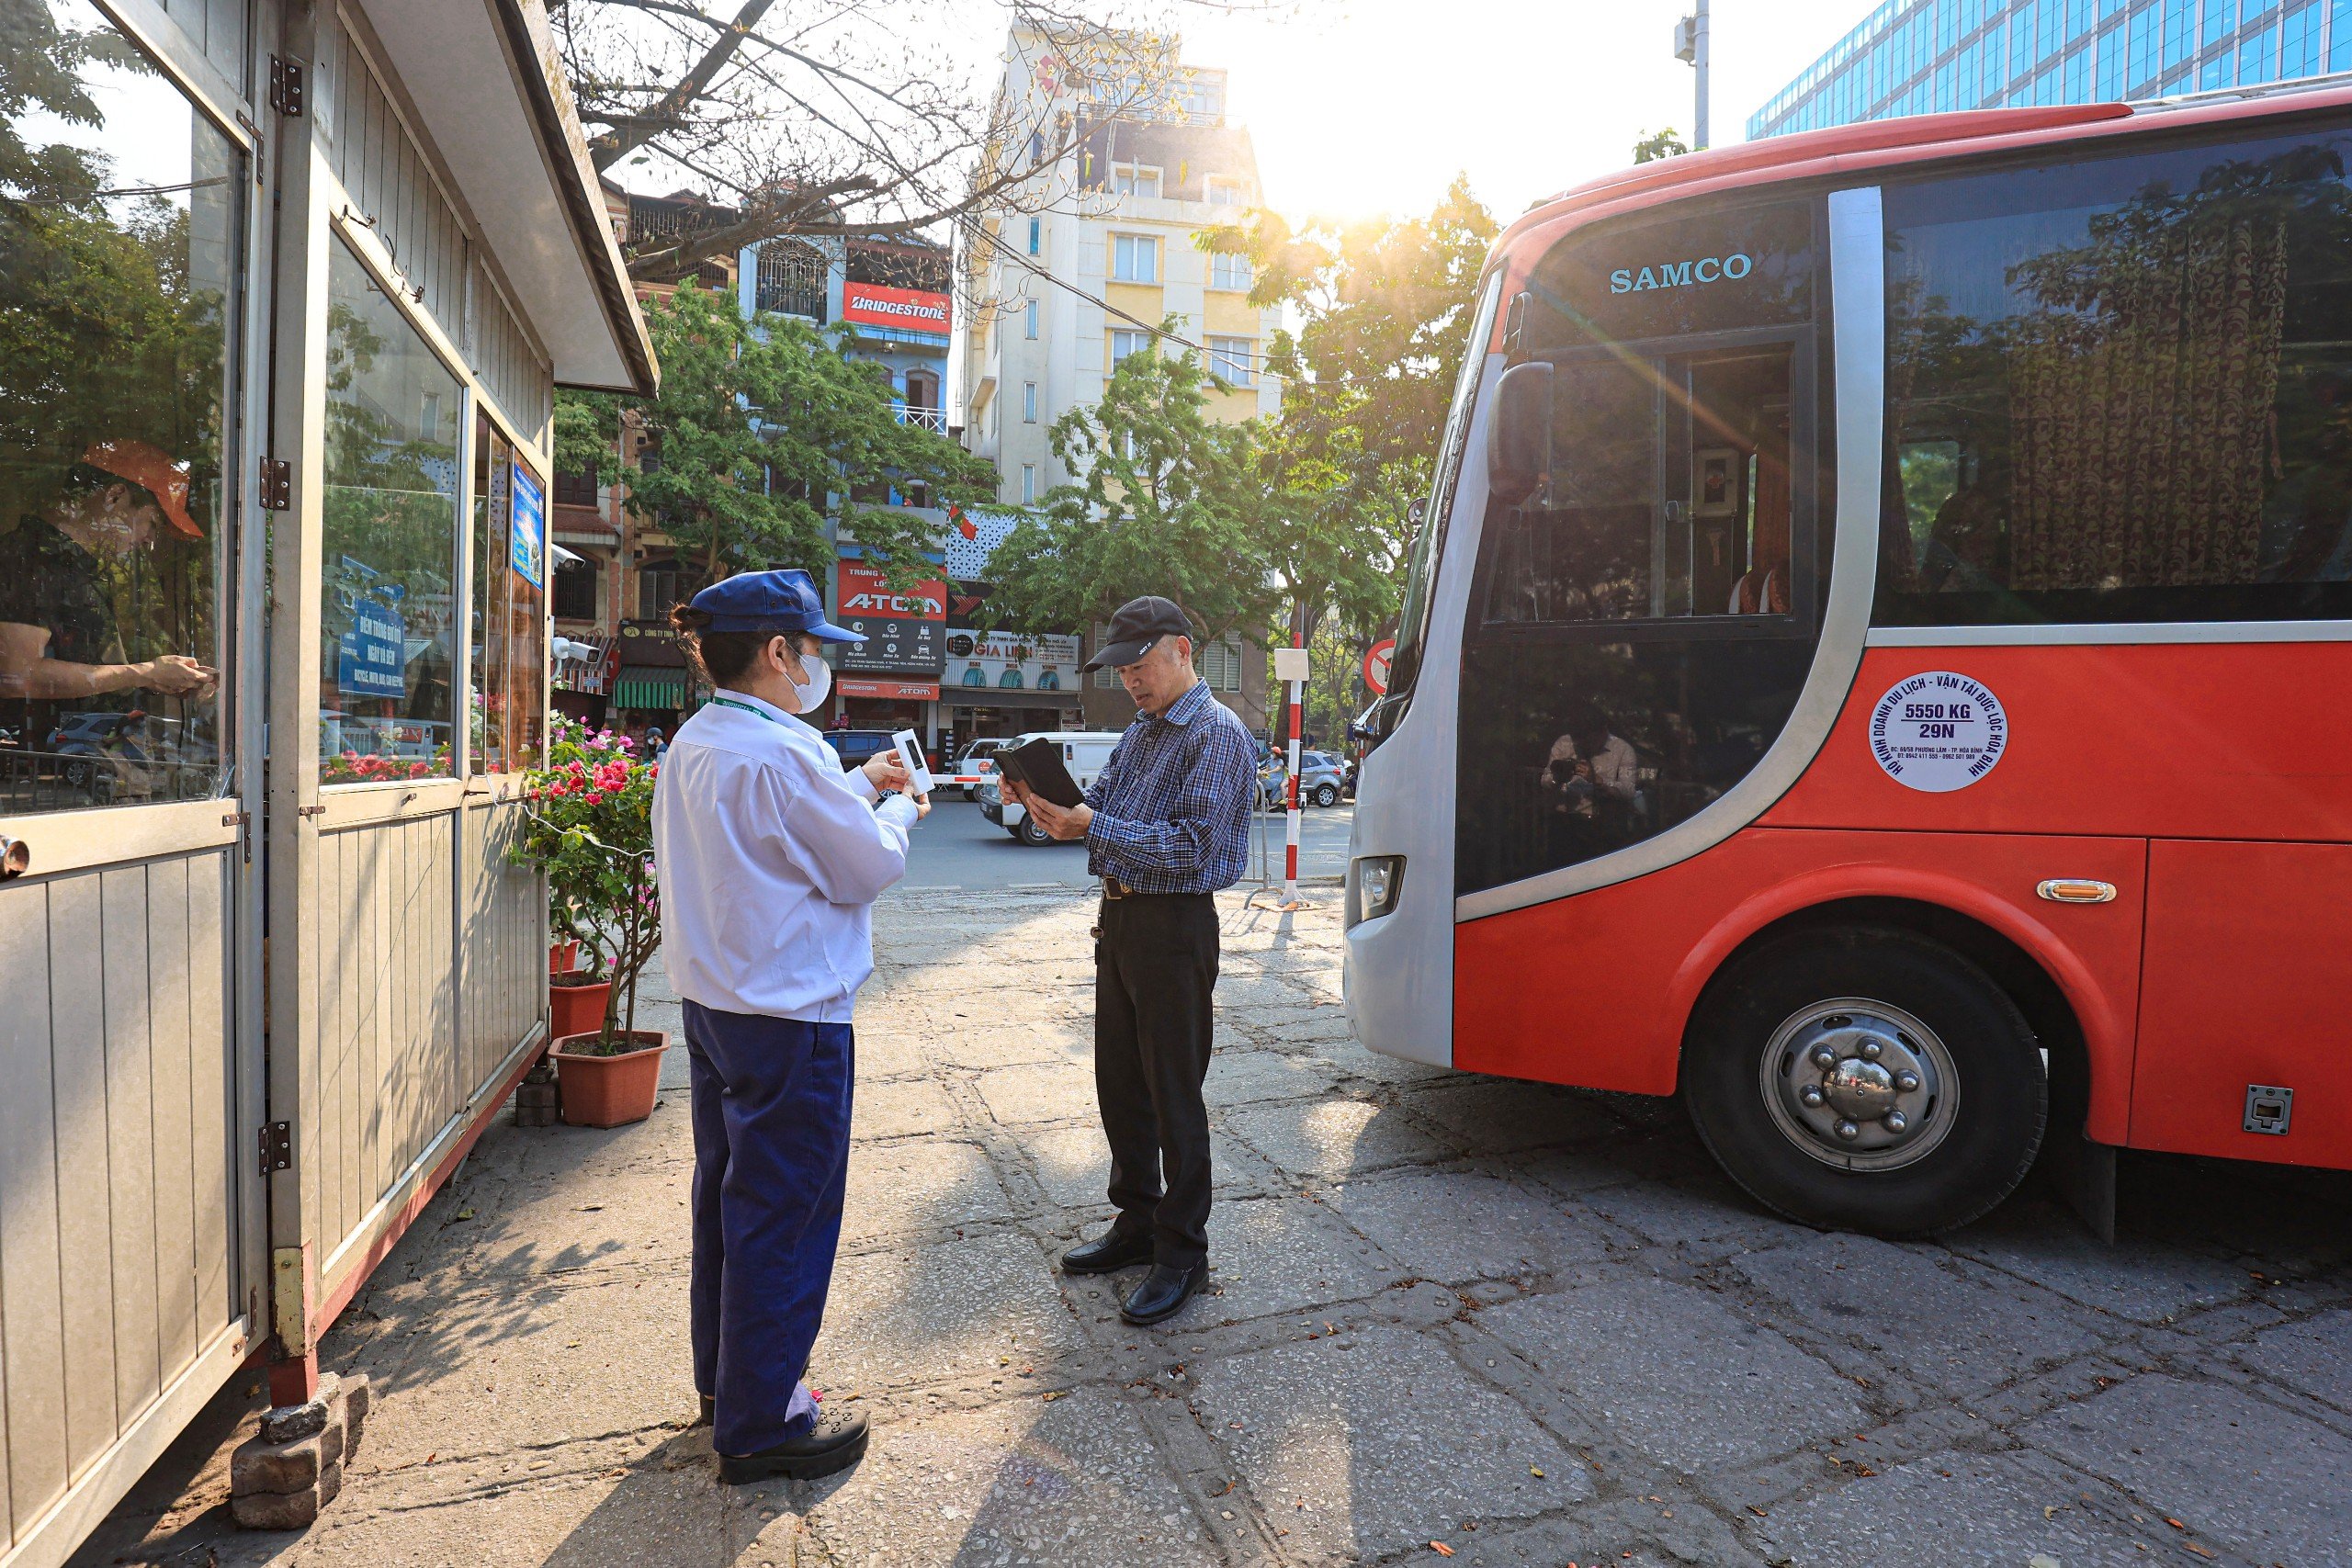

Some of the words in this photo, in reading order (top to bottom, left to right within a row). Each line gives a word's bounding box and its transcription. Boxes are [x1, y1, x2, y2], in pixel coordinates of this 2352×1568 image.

[1610, 254, 1752, 294] SAMCO
[851, 296, 946, 320] BRIDGESTONE
[849, 569, 878, 577] TRUNG
[975, 644, 1000, 657] GIA
[1901, 677, 1927, 695] LỊCH
[1937, 673, 1960, 690] VẬN
[1961, 681, 1979, 696] TẢI
[1887, 690, 1903, 705] DU
[1974, 692, 1996, 712] ĐỨC
[1873, 704, 1893, 736] DOANH
[1905, 704, 1944, 719] 5550
[1949, 704, 1971, 719] KG
[1986, 712, 2004, 731] LỘC
[1919, 724, 1955, 739] 29N
[1874, 739, 1893, 762] KINH
[1985, 734, 2004, 753] HÒA
[1968, 754, 1994, 777] BÌNH
